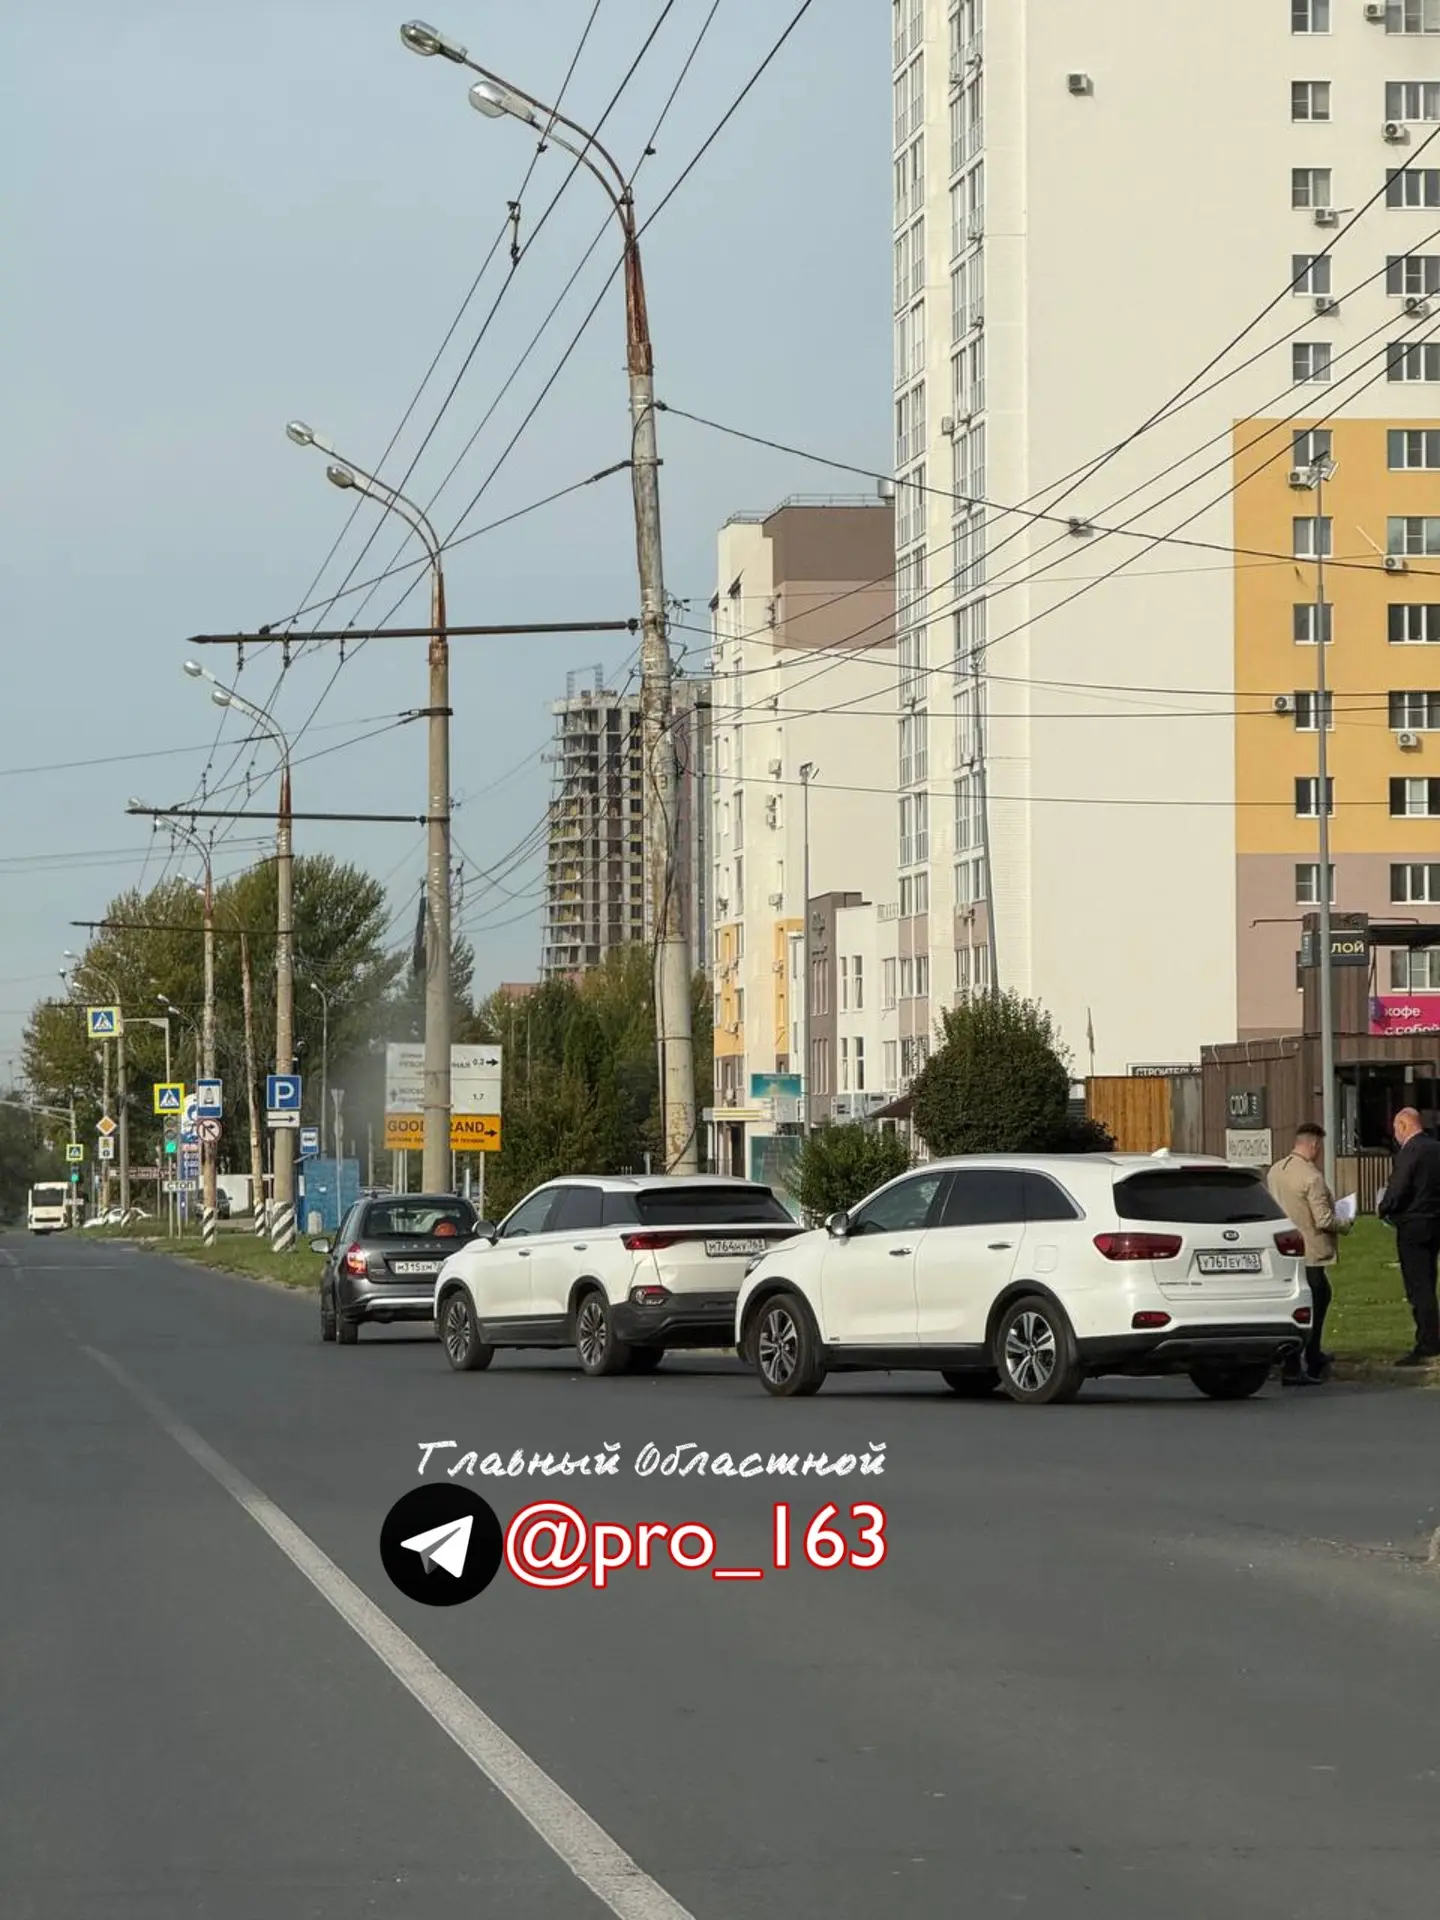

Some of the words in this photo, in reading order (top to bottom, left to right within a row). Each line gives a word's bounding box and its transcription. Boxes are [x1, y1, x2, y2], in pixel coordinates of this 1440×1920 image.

[1331, 940, 1365, 954] ЛОЙ
[1384, 1004, 1421, 1019] кофе
[275, 1081, 295, 1108] P
